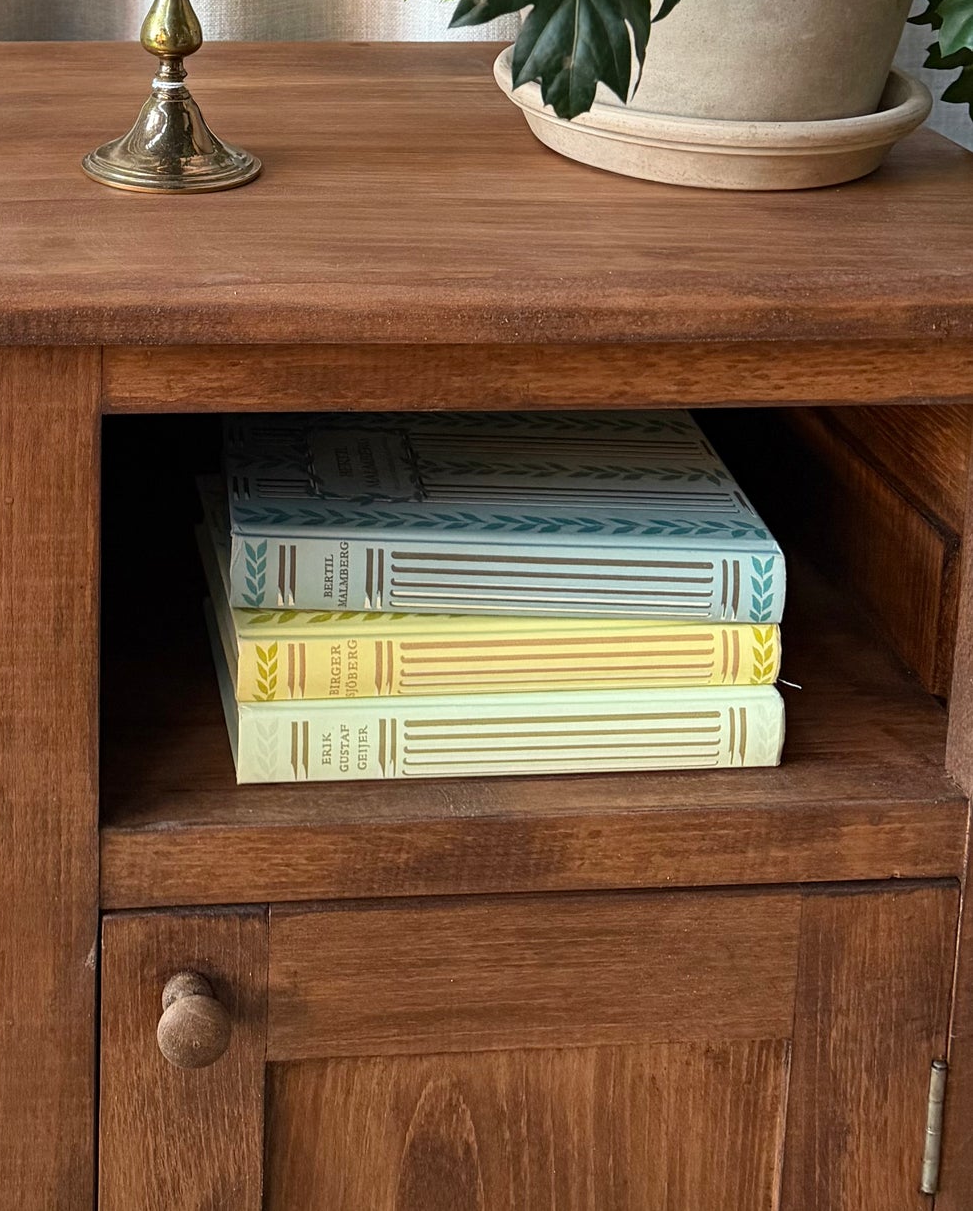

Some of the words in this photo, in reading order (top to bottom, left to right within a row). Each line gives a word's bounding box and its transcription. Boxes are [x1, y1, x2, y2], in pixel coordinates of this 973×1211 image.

[324, 554, 334, 598] BERTIL
[338, 541, 350, 608] MALMBERG
[329, 645, 341, 695] BIRGER
[346, 639, 358, 698] SJÖBERG
[322, 732, 332, 765] ERIK
[339, 724, 351, 773] GUSTAF
[357, 725, 369, 771] GEIJER
